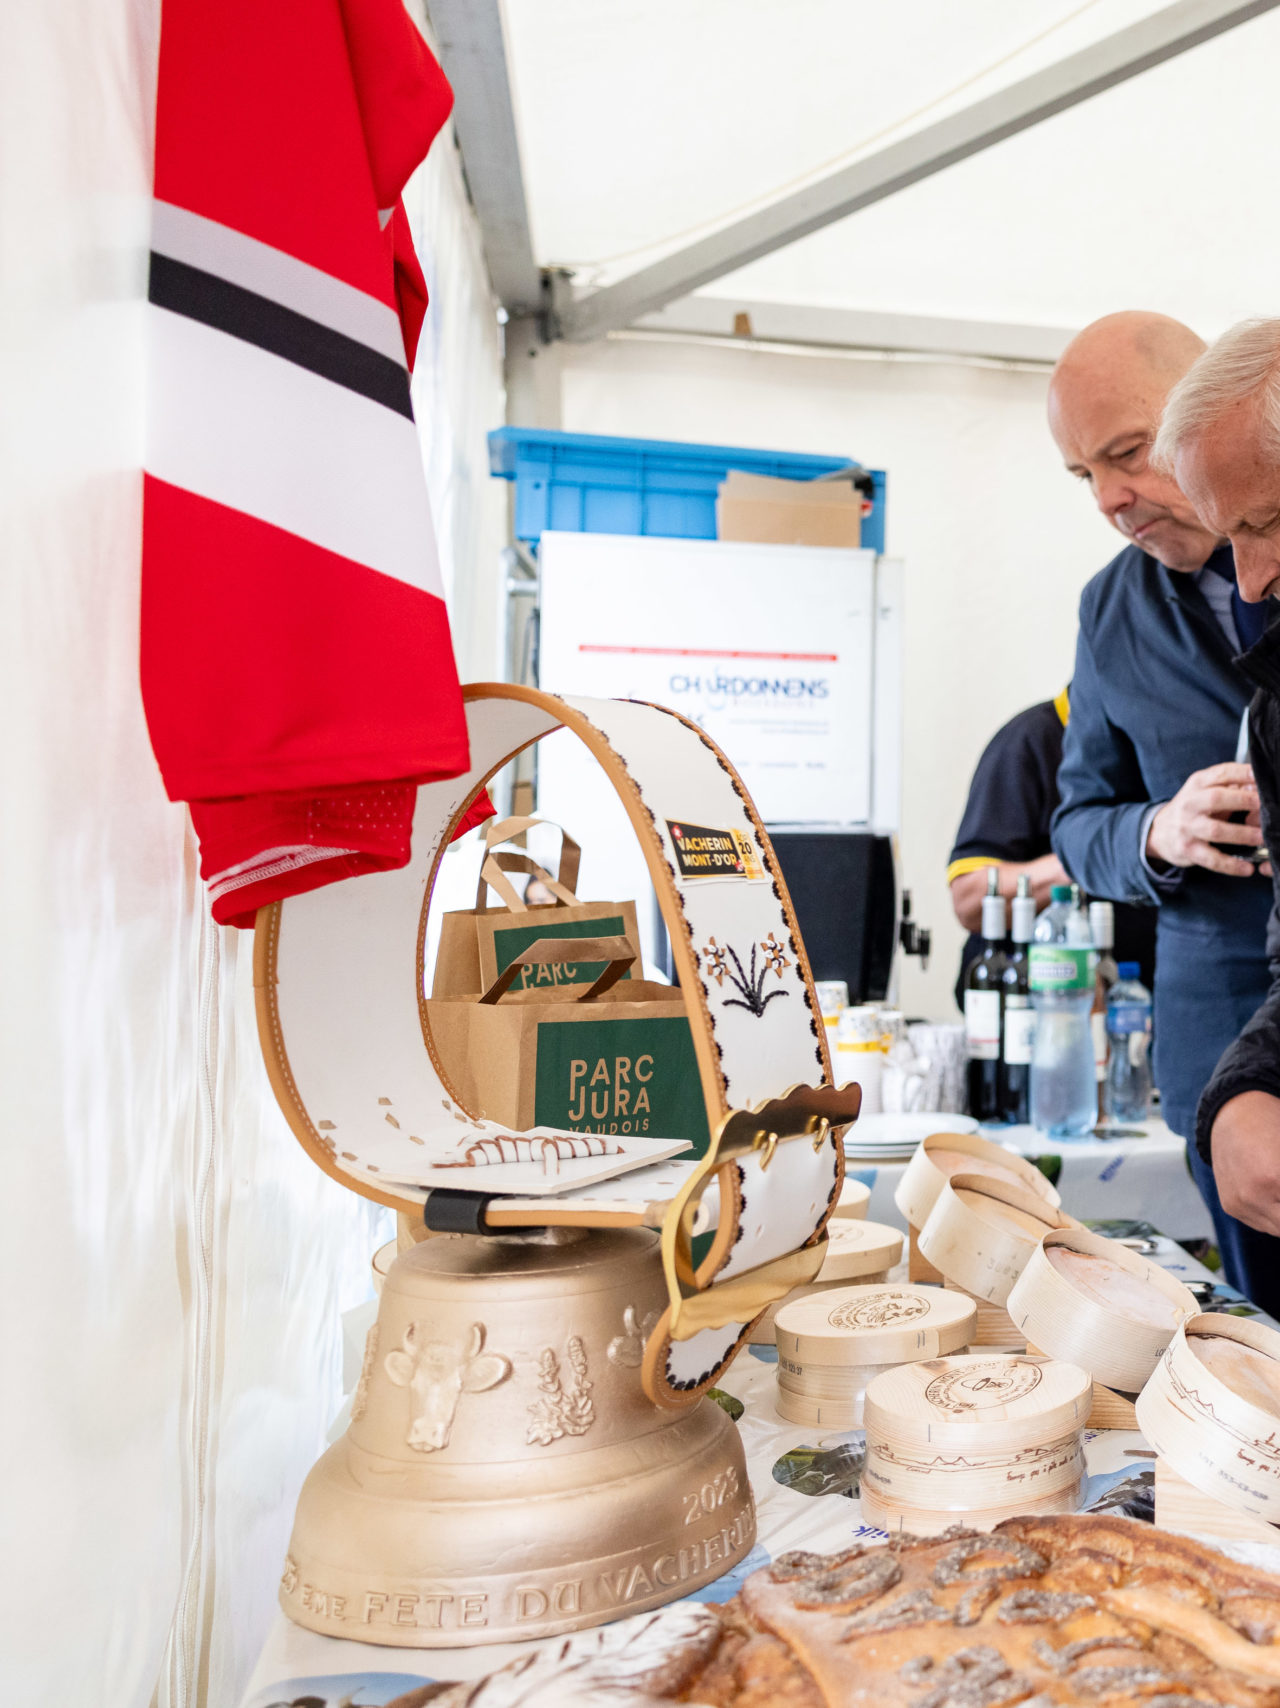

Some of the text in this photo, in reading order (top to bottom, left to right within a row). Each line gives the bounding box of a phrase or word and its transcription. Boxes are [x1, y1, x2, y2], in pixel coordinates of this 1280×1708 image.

[677, 837, 733, 851] VACHERIN
[739, 842, 752, 854] 20
[682, 854, 737, 866] MONT-D'OR
[521, 963, 577, 988] PARC
[570, 1055, 654, 1100] PARC
[568, 1086, 651, 1121] JURA
[682, 1466, 739, 1526] 2023
[362, 1590, 488, 1628] FETE
[515, 1580, 582, 1624] DU
